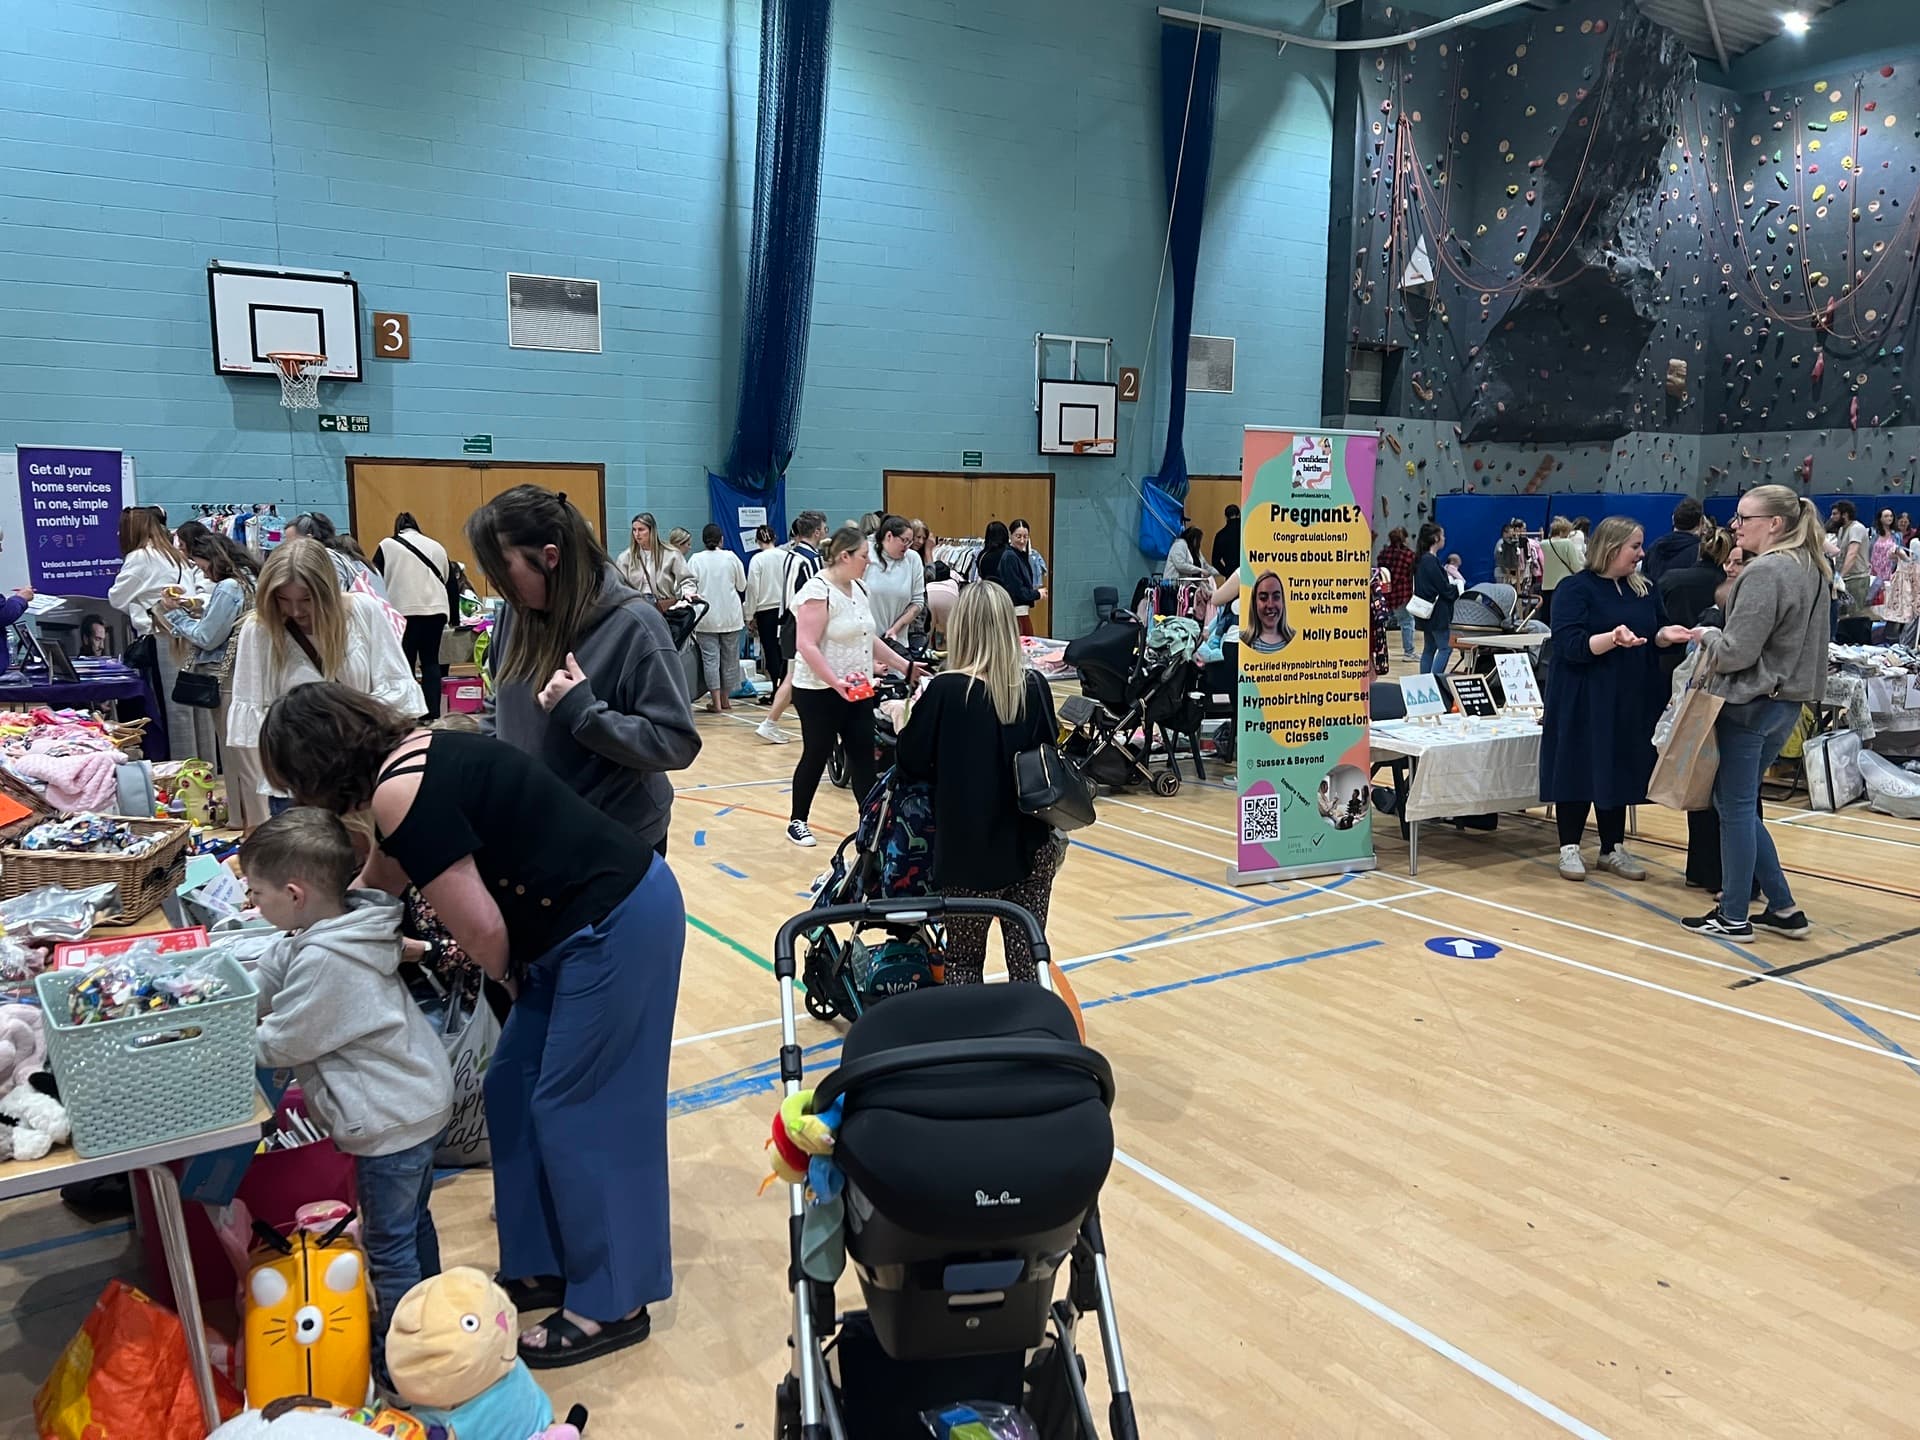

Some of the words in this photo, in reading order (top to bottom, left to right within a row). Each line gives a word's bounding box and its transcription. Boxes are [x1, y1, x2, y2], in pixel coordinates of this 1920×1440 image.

[382, 318, 403, 352] 3
[1123, 372, 1135, 397] 2
[351, 416, 368, 424] FIRE
[351, 424, 369, 432] EXIT
[1298, 455, 1328, 464] confident
[29, 463, 52, 475] Get
[54, 464, 66, 475] all
[67, 466, 92, 478] your
[1303, 464, 1322, 472] births
[31, 481, 65, 492] home
[66, 481, 111, 493] services
[33, 498, 46, 509] in
[48, 499, 71, 511] one,
[72, 498, 108, 511] simple
[36, 515, 81, 528] monthly
[82, 514, 99, 526] bill
[1270, 504, 1361, 527] Pregnant?
[1273, 531, 1348, 544] (Congratulations!)
[1249, 550, 1298, 563] Nervous
[1300, 549, 1333, 562] about
[1335, 549, 1370, 562] Birth?
[41, 560, 66, 569] Unlock
[1288, 577, 1311, 588] Turn
[1312, 578, 1334, 589] your
[1335, 577, 1369, 588] nerves
[1290, 590, 1310, 601] into
[1311, 589, 1367, 601] excitement
[1309, 603, 1331, 614] with
[1332, 605, 1348, 614] me
[1302, 628, 1331, 642] Molly
[1243, 661, 1281, 672] Certified
[1281, 659, 1338, 671] Hypnobirthing
[1238, 672, 1282, 683] Antenatal
[1283, 672, 1298, 681] and
[1299, 670, 1340, 681] Postnatal
[1341, 670, 1369, 680] Suppor
[1242, 691, 1324, 709] Hypnobirthing
[1245, 716, 1306, 734] Pregnancy
[1308, 713, 1369, 728] Relaxation
[1285, 731, 1329, 744] Classes
[1256, 757, 1285, 768] Sussex
[1286, 757, 1293, 767] &
[1294, 755, 1325, 766] Beyond
